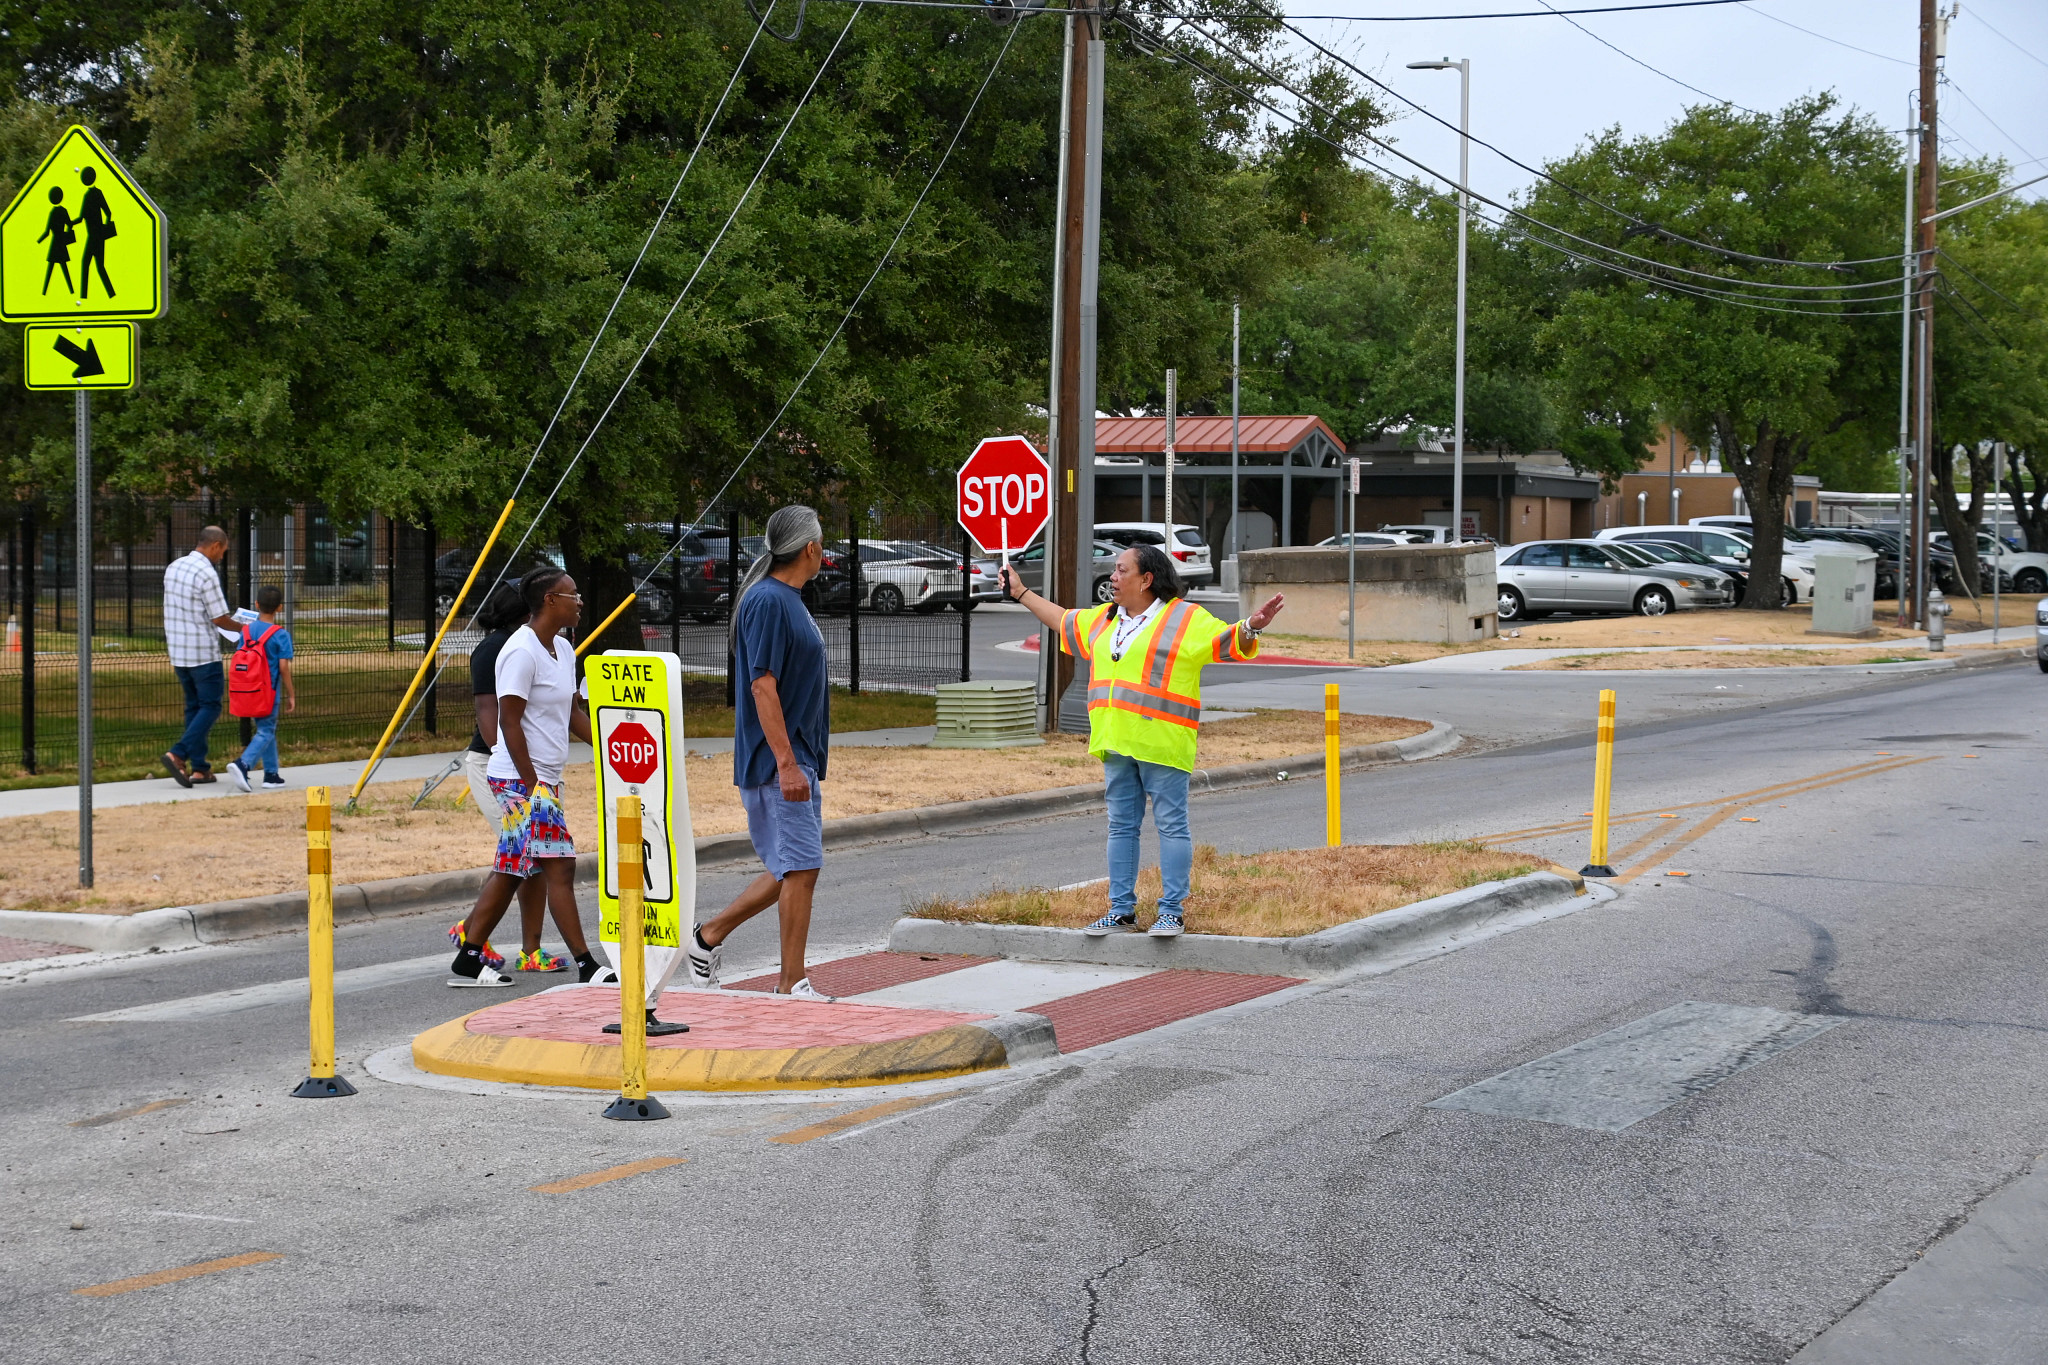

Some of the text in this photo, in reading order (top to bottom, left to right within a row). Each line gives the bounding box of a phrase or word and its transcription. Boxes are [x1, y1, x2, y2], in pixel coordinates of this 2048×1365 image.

[963, 473, 1045, 518] STOP
[601, 662, 653, 682] STATE
[611, 684, 646, 704] LAW
[611, 741, 655, 765] STOP
[607, 921, 672, 940] CRWALK
